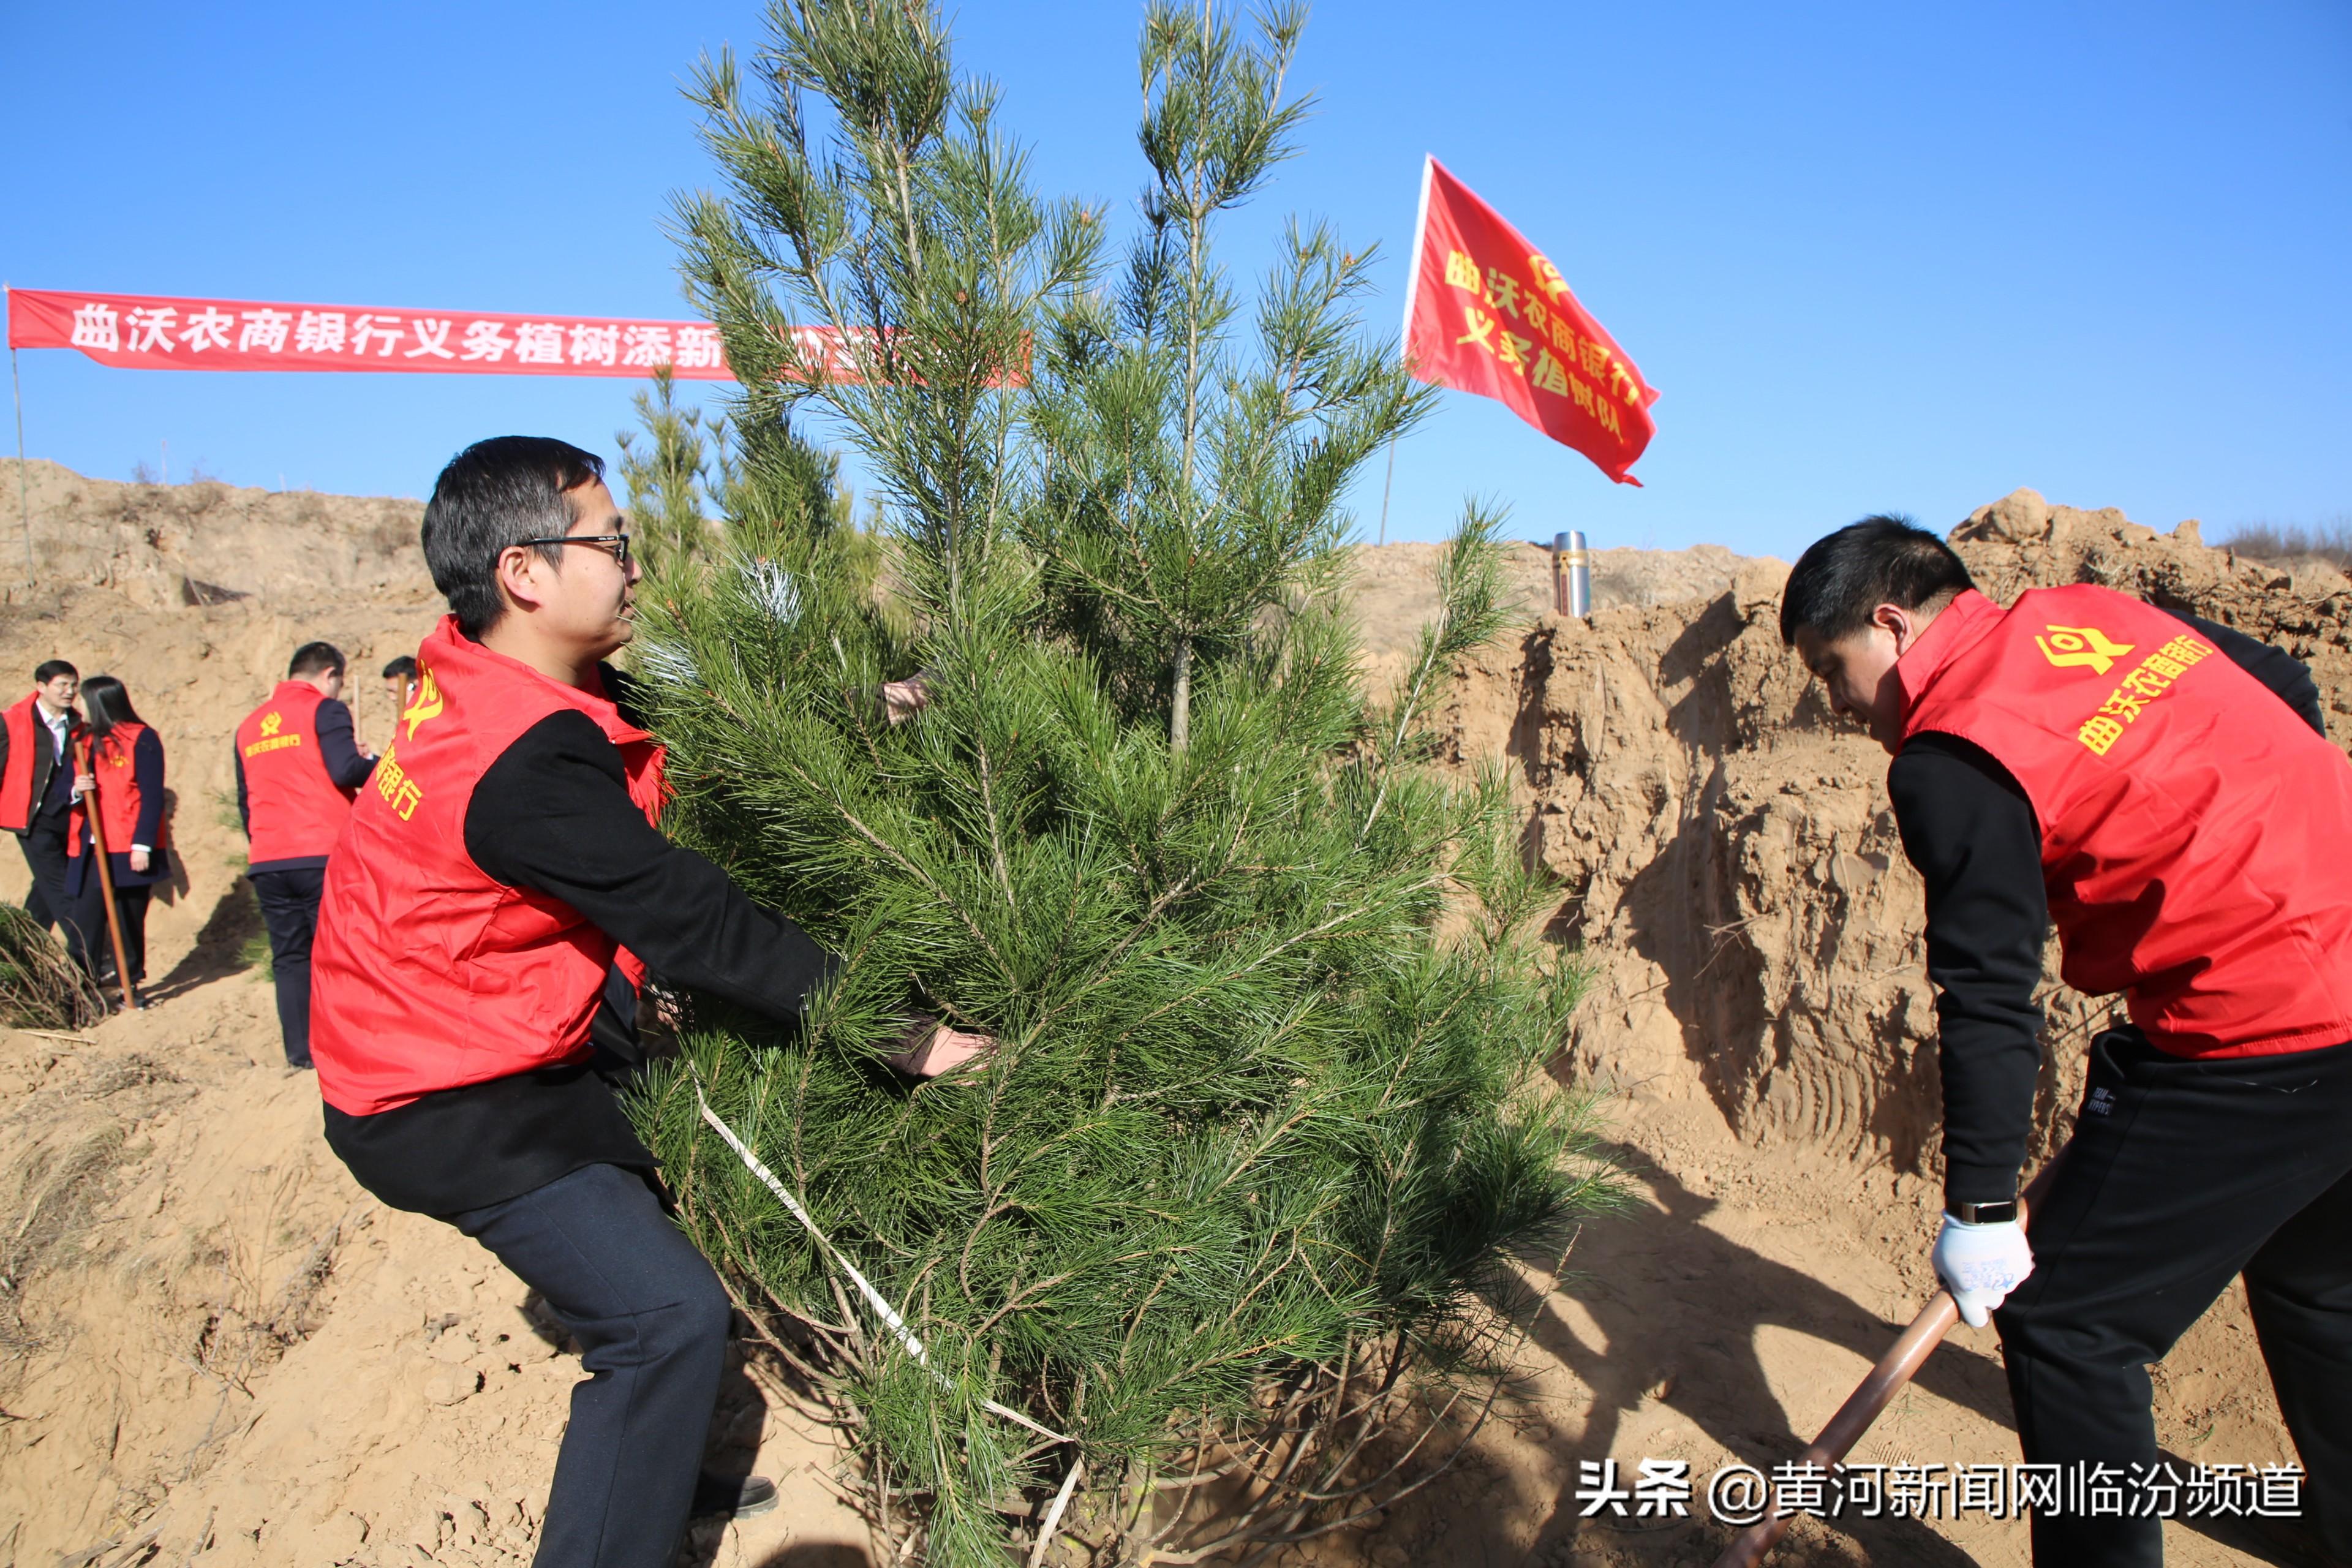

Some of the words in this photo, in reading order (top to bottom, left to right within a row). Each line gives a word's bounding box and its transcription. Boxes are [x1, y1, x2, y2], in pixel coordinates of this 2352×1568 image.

[1445, 249, 1640, 406] 曲沃农商银行
[1456, 306, 1624, 444] 义务植树队
[2078, 634, 2214, 756] 曲沃农商银行
